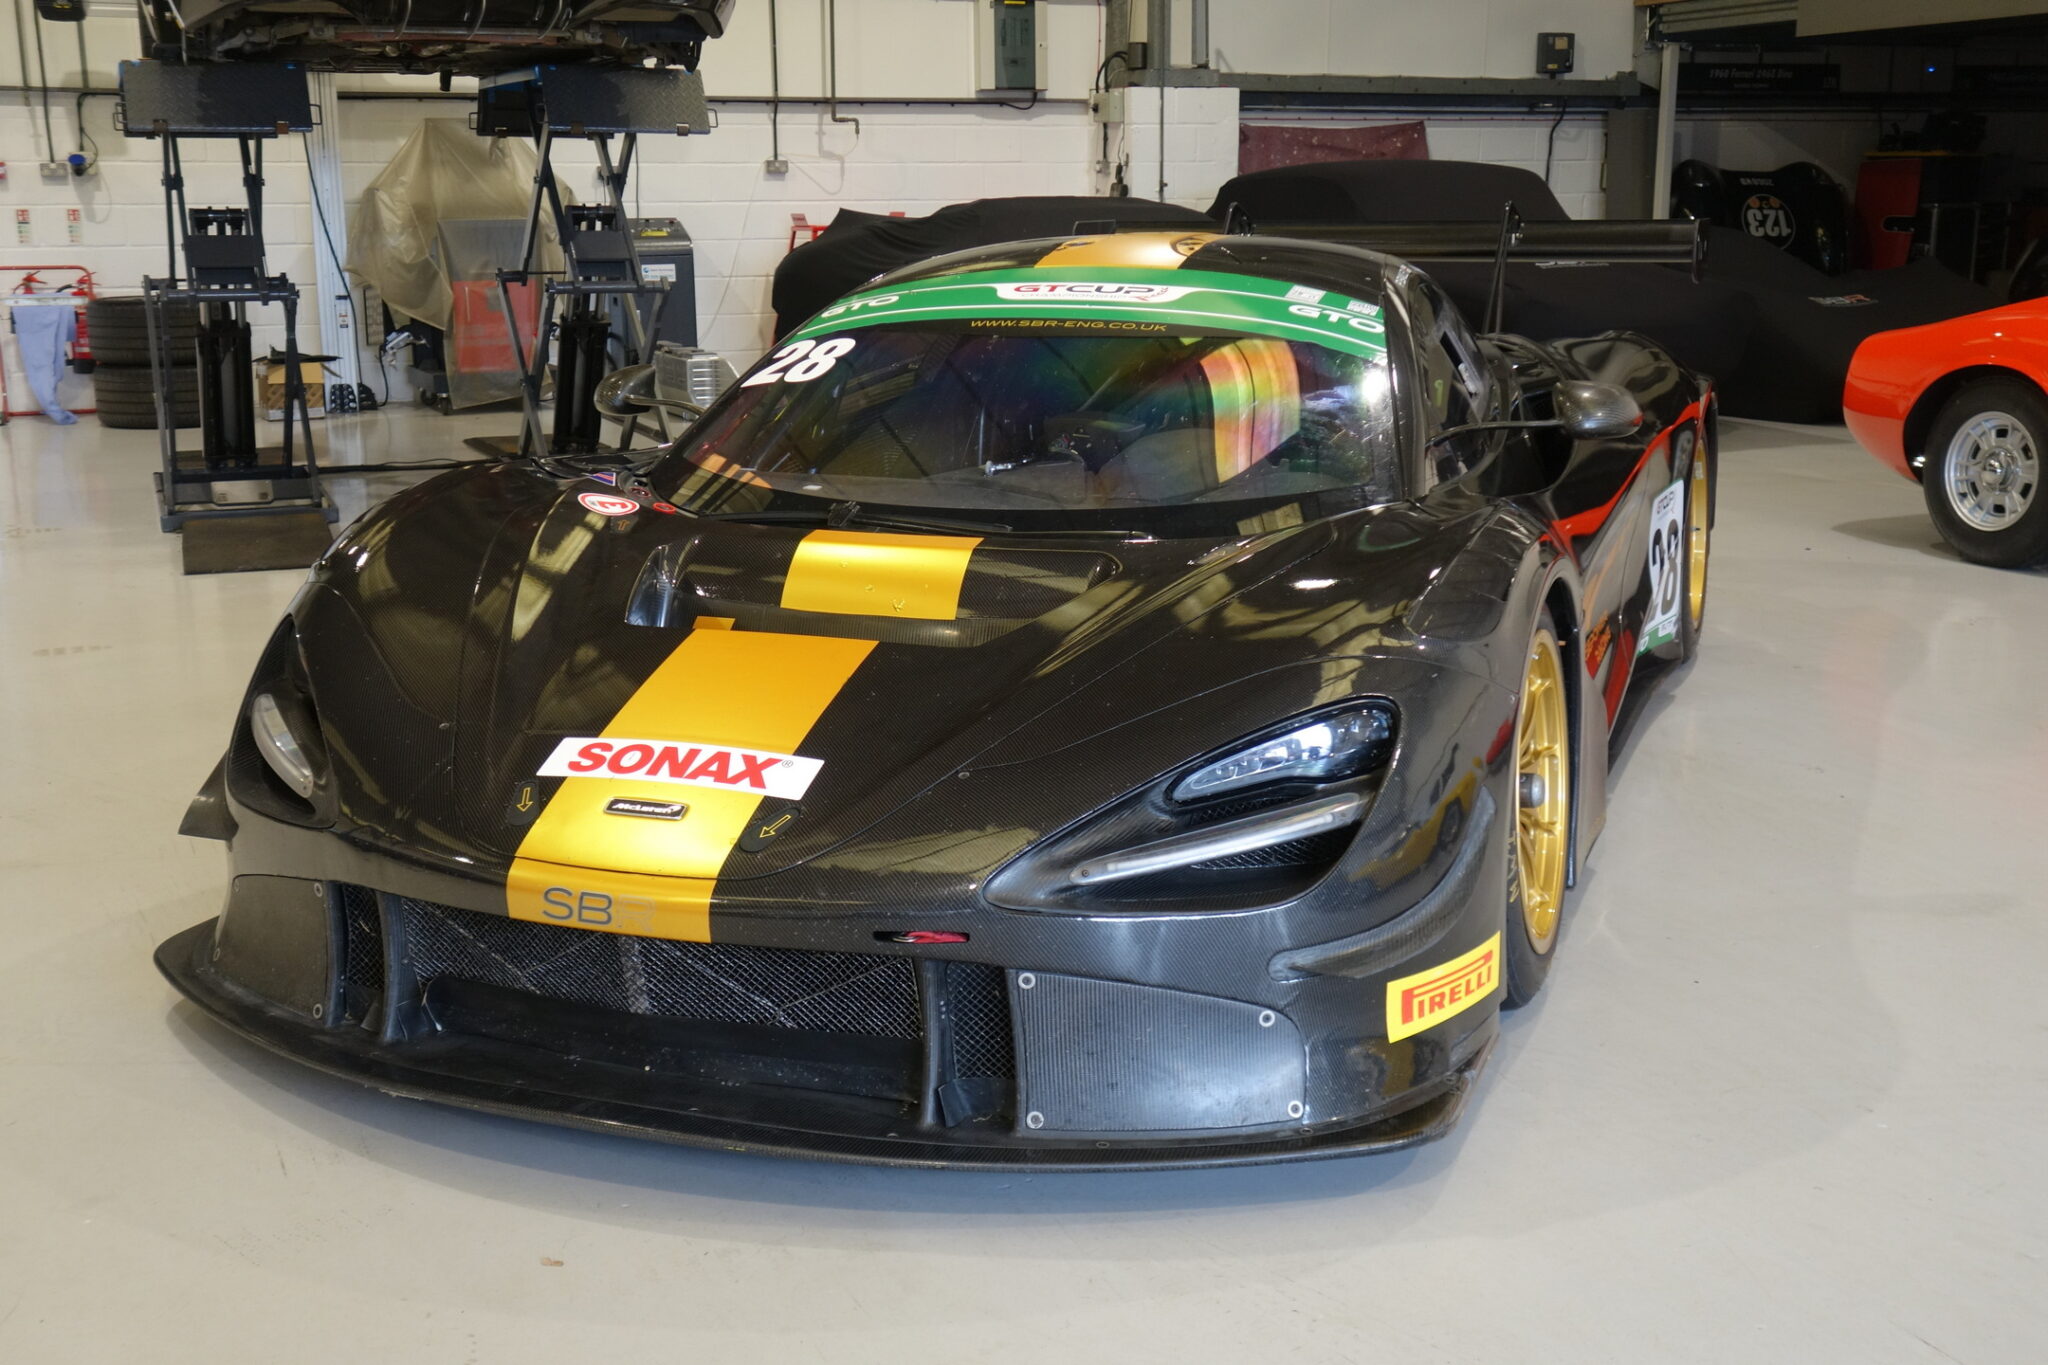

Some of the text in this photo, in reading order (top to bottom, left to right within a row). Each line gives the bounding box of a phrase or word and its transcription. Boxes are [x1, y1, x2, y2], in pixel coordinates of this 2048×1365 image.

[1747, 209, 1792, 237] 123
[821, 295, 900, 318] GTO
[1021, 292, 1127, 300] CHAMPIONSHIP
[970, 318, 1168, 332] WWW.SBR-ENG.CO.UK
[1288, 304, 1386, 334] GTO
[740, 337, 857, 389] 28
[1646, 518, 1680, 624] 28
[612, 802, 674, 814] McLaren
[542, 886, 656, 933] SBR
[1402, 950, 1493, 1025] PIRELLI
